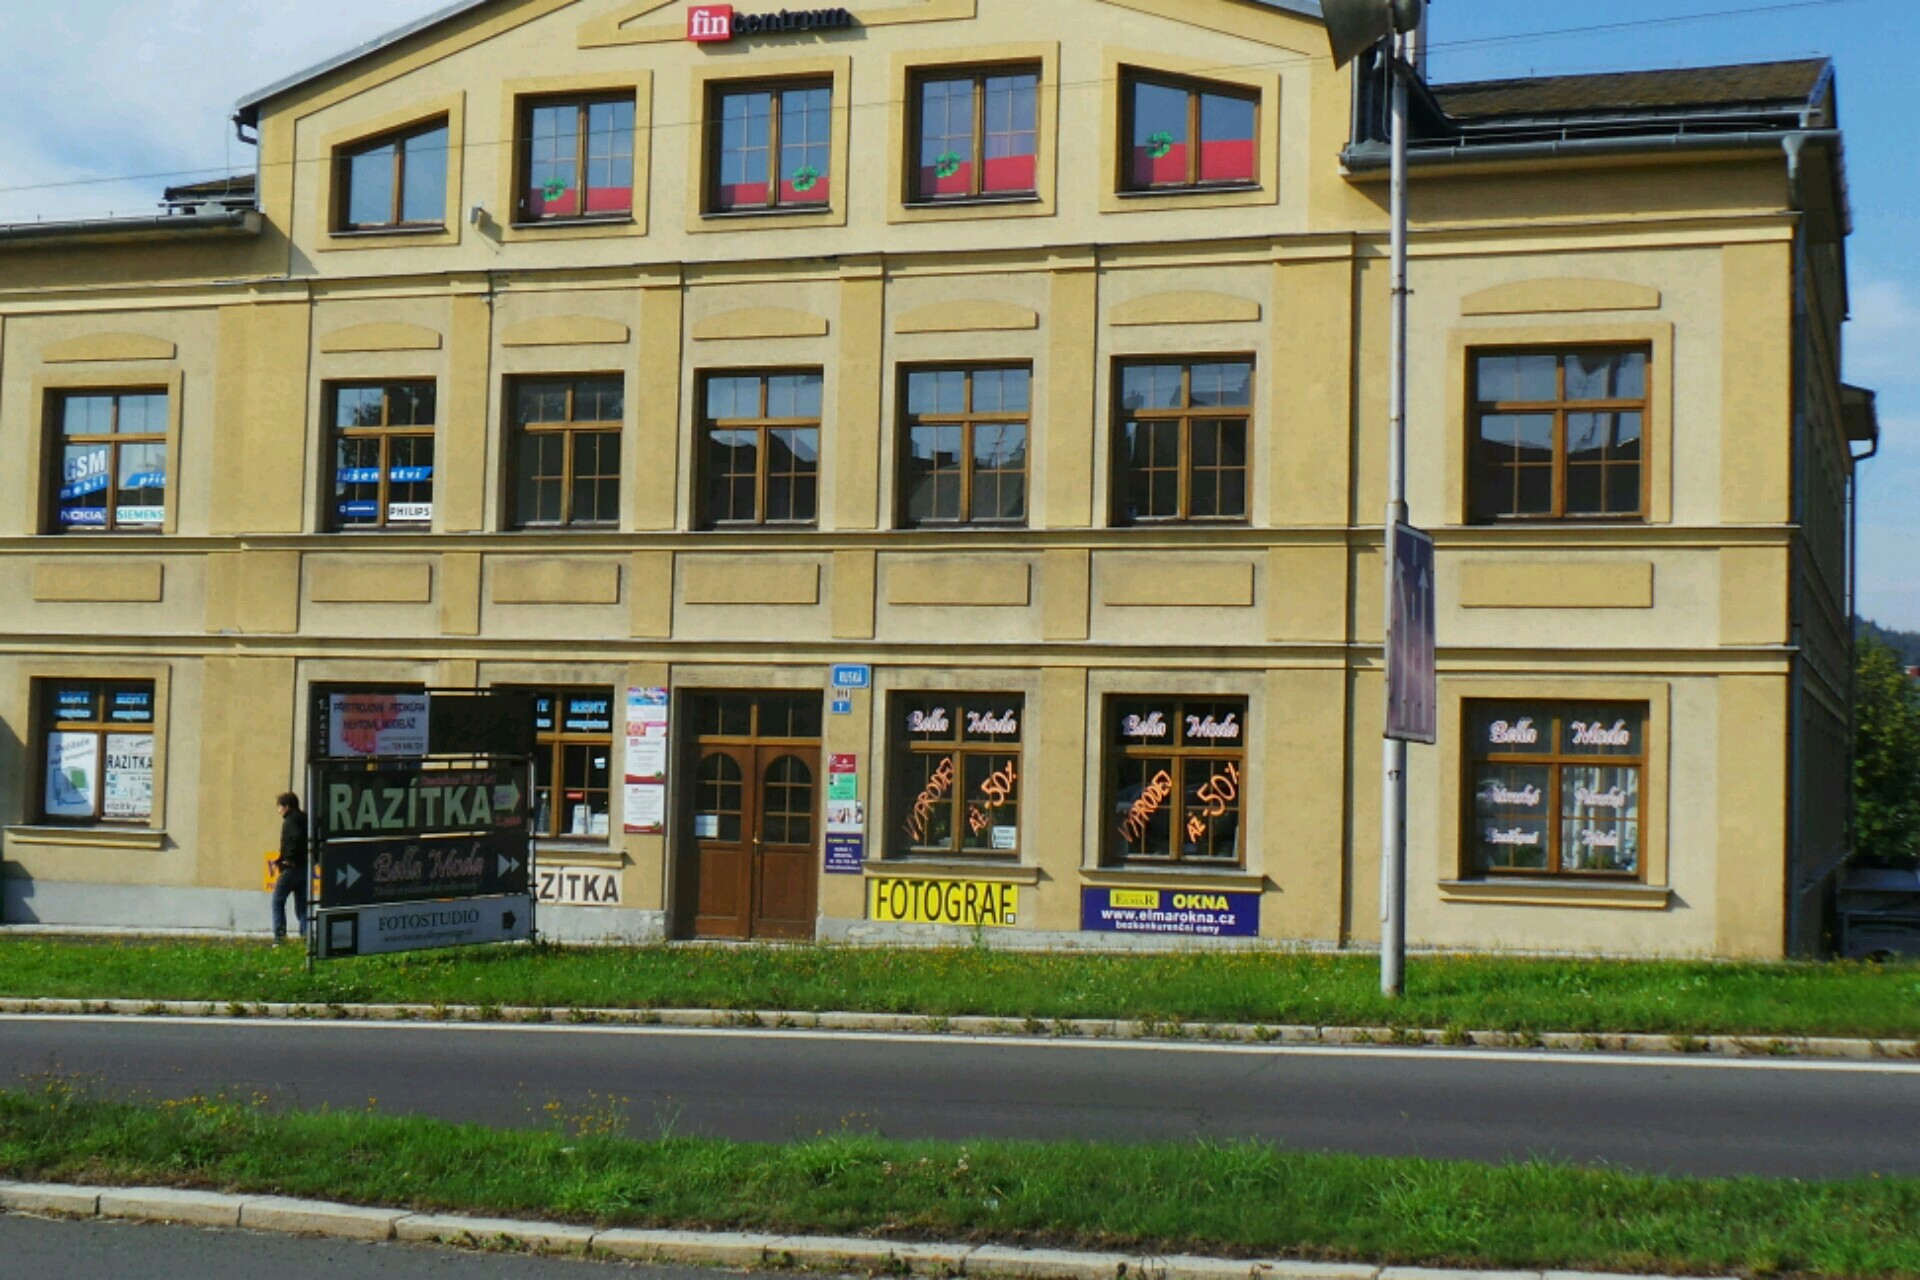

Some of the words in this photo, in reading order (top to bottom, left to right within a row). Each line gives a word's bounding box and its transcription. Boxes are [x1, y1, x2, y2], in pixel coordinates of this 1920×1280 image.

[64, 449, 105, 482] GSM
[60, 511, 102, 520] NOKIA
[116, 509, 165, 520] SIEMENS
[390, 506, 430, 516] PHILIPS
[329, 778, 493, 831] RAZÍTKA
[537, 865, 619, 903] ZÍTKA
[876, 878, 1013, 924] FOTOGRAF
[1172, 893, 1229, 910] OKNA
[378, 908, 480, 931] FOTOSTUDIO
[1101, 908, 1236, 925] www.elmarokna.cz
